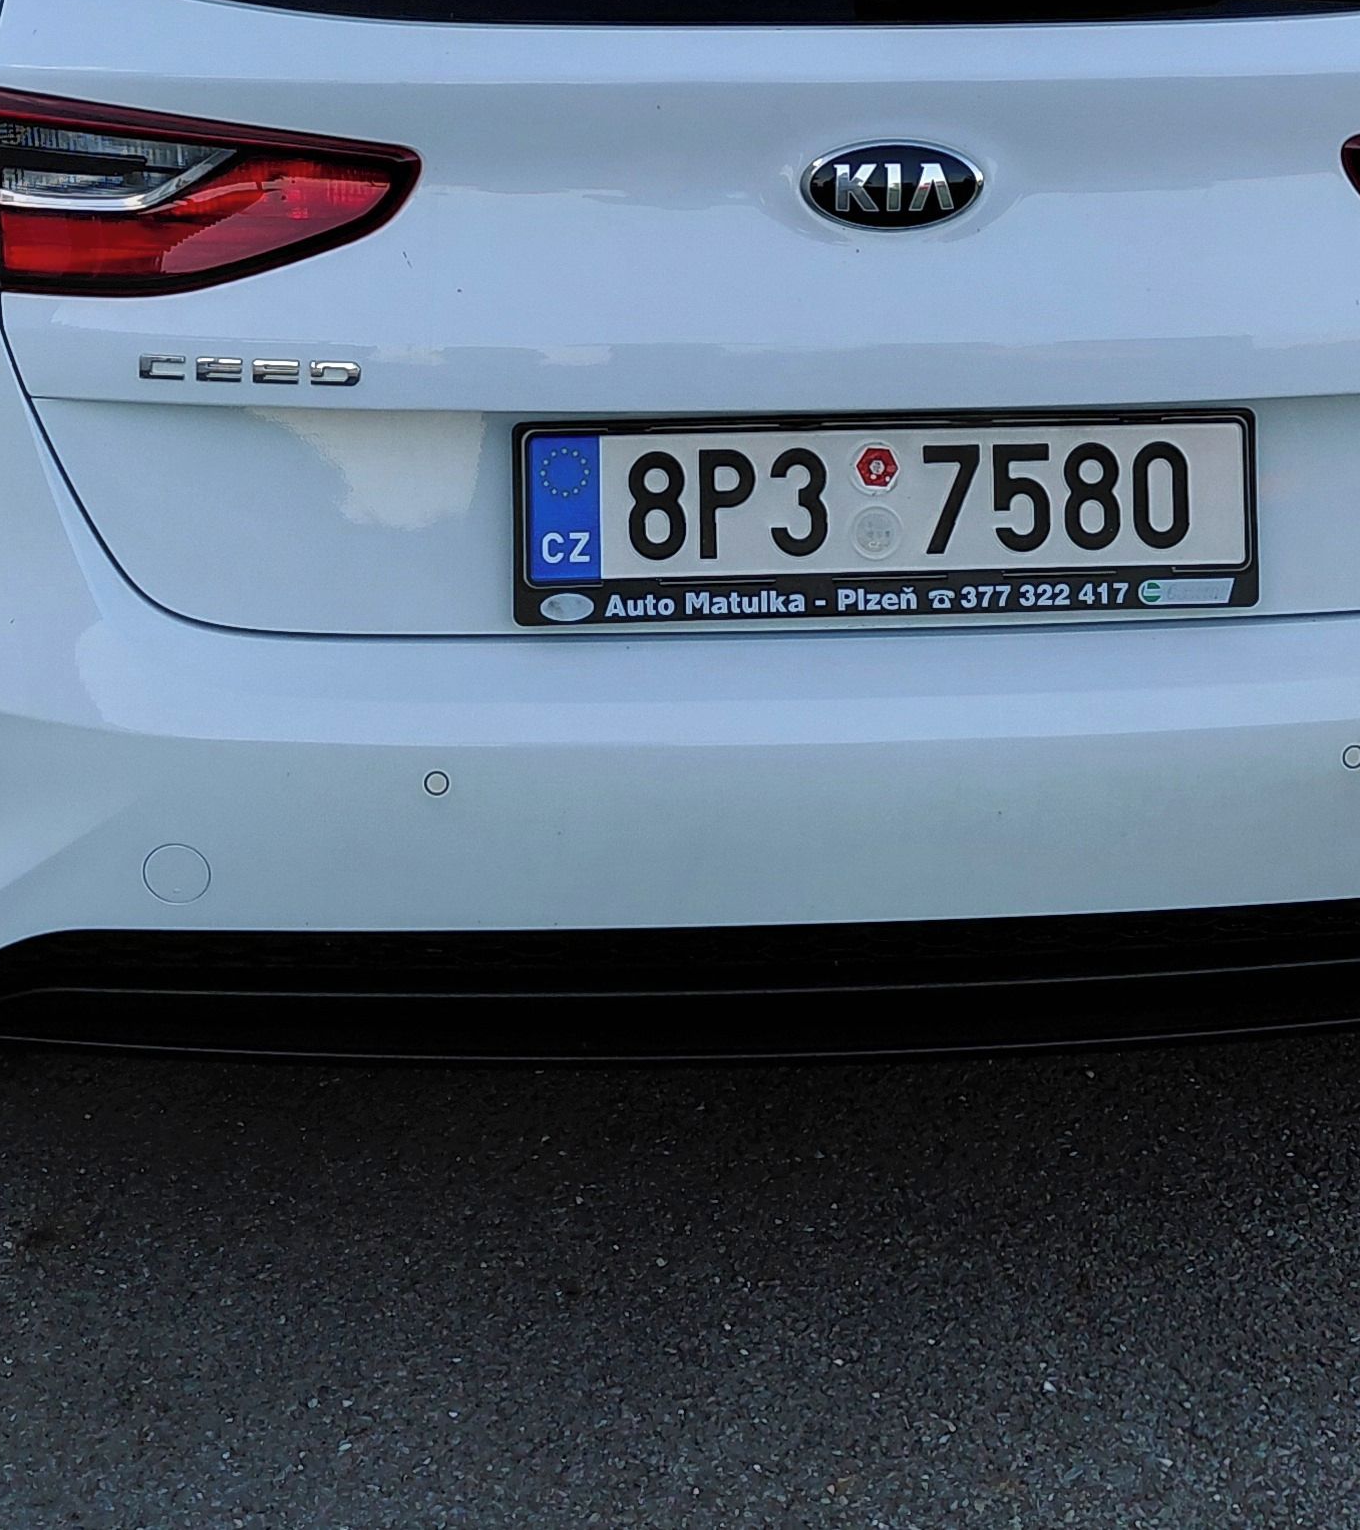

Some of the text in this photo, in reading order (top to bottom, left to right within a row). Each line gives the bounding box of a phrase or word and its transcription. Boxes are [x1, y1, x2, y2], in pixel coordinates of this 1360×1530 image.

[833, 163, 955, 212] KIA
[139, 354, 362, 387] CEED
[627, 440, 1190, 561] 8P3 7580
[540, 532, 591, 564] CZ
[604, 594, 675, 617] Auto
[685, 590, 805, 615] Matulka
[837, 587, 917, 611] Plzeň
[960, 585, 1012, 608] 377
[1019, 583, 1070, 607] 322
[1078, 582, 1129, 604] 417
